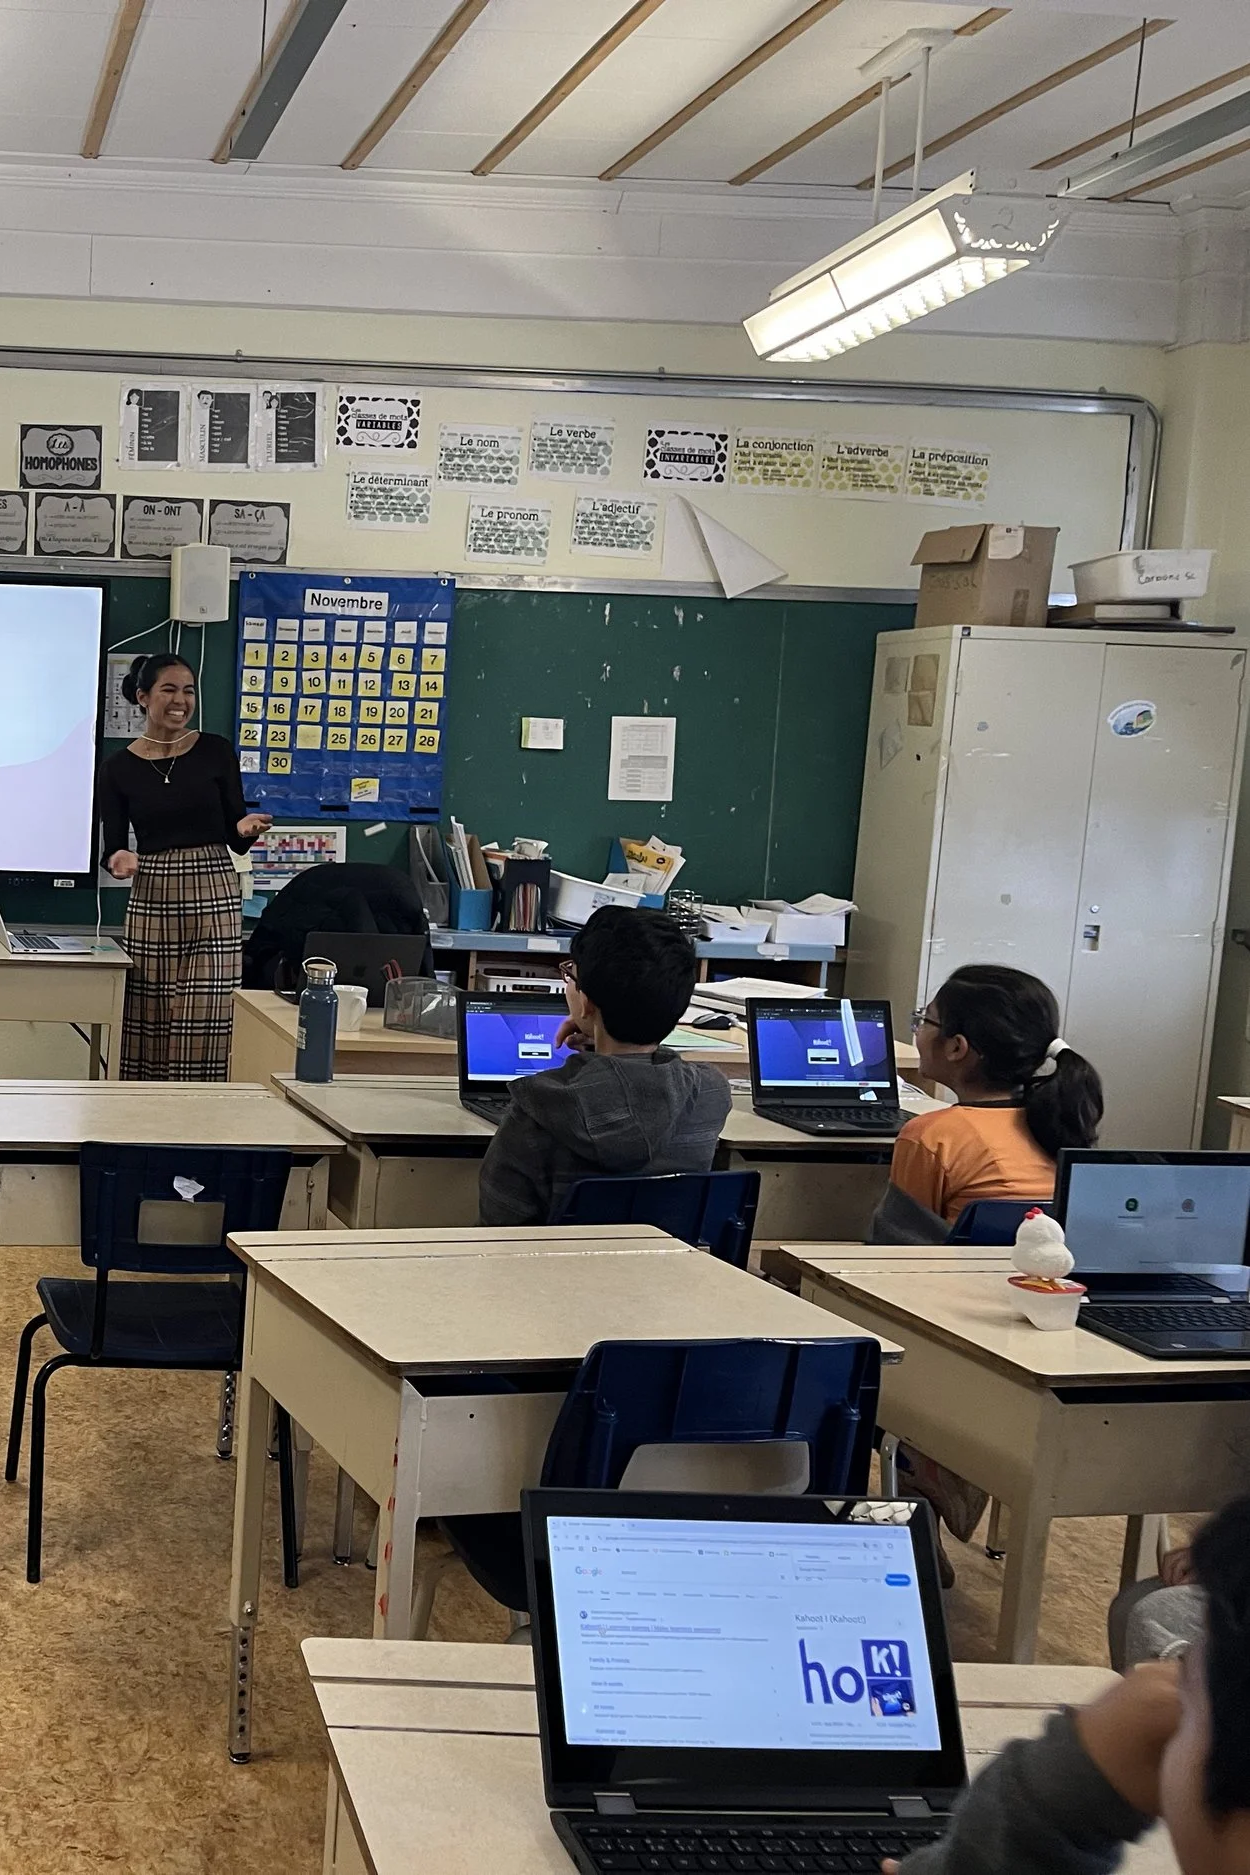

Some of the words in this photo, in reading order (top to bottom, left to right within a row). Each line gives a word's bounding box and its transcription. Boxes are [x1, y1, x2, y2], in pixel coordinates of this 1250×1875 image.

[351, 411, 377, 420] classes
[356, 420, 402, 430] VARIABLES
[550, 426, 563, 437] Le
[566, 428, 597, 439] verbe
[198, 423, 206, 462] MASCULIN
[459, 436, 473, 447] Le
[476, 438, 500, 448] nom
[736, 438, 750, 449] La
[752, 439, 814, 452] conjonction
[686, 446, 696, 454] de
[837, 444, 889, 458] L'adverbe
[24, 455, 98, 472] HOMOPHONES
[660, 453, 715, 465] INVARIABLES
[912, 449, 927, 460] La
[929, 450, 989, 466] préposition
[353, 474, 366, 484] Le
[368, 475, 429, 487] déterminant
[64, 501, 71, 512] A
[143, 504, 156, 515] ON
[163, 505, 182, 517] ONT
[592, 501, 642, 515] L'adjectif
[234, 508, 246, 520] SA
[254, 509, 266, 522] ÇA
[480, 508, 494, 518] Le
[496, 510, 539, 521] pronom
[310, 592, 383, 610] Novembre
[254, 650, 259, 660] 1
[281, 650, 289, 661] 2
[310, 652, 319, 662] 3
[339, 653, 347, 663] 4
[367, 652, 375, 662] 5
[397, 653, 405, 664] 6
[430, 654, 438, 665] 7
[250, 675, 258, 686] 8
[280, 677, 288, 687] 9
[308, 676, 321, 687] 10
[337, 679, 346, 689] 11
[364, 680, 376, 690] 12
[398, 680, 410, 691] 13
[425, 681, 438, 691] 14
[246, 702, 258, 713] 15
[272, 703, 285, 714] 16
[304, 704, 316, 715] 17
[334, 706, 346, 717] 18
[366, 706, 378, 717] 19
[389, 707, 405, 718] 20
[420, 708, 433, 719] 21
[243, 729, 258, 740] 22
[270, 731, 286, 742] 23
[331, 733, 347, 744] 25
[360, 734, 376, 745] 26
[387, 735, 403, 746] 27
[418, 735, 435, 747] 28
[242, 756, 254, 767] 29
[271, 757, 288, 768] 30
[575, 1565, 603, 1577] Google
[794, 1614, 824, 1623] Kahoot
[870, 1643, 902, 1677] K!
[798, 1637, 865, 1705] ho
